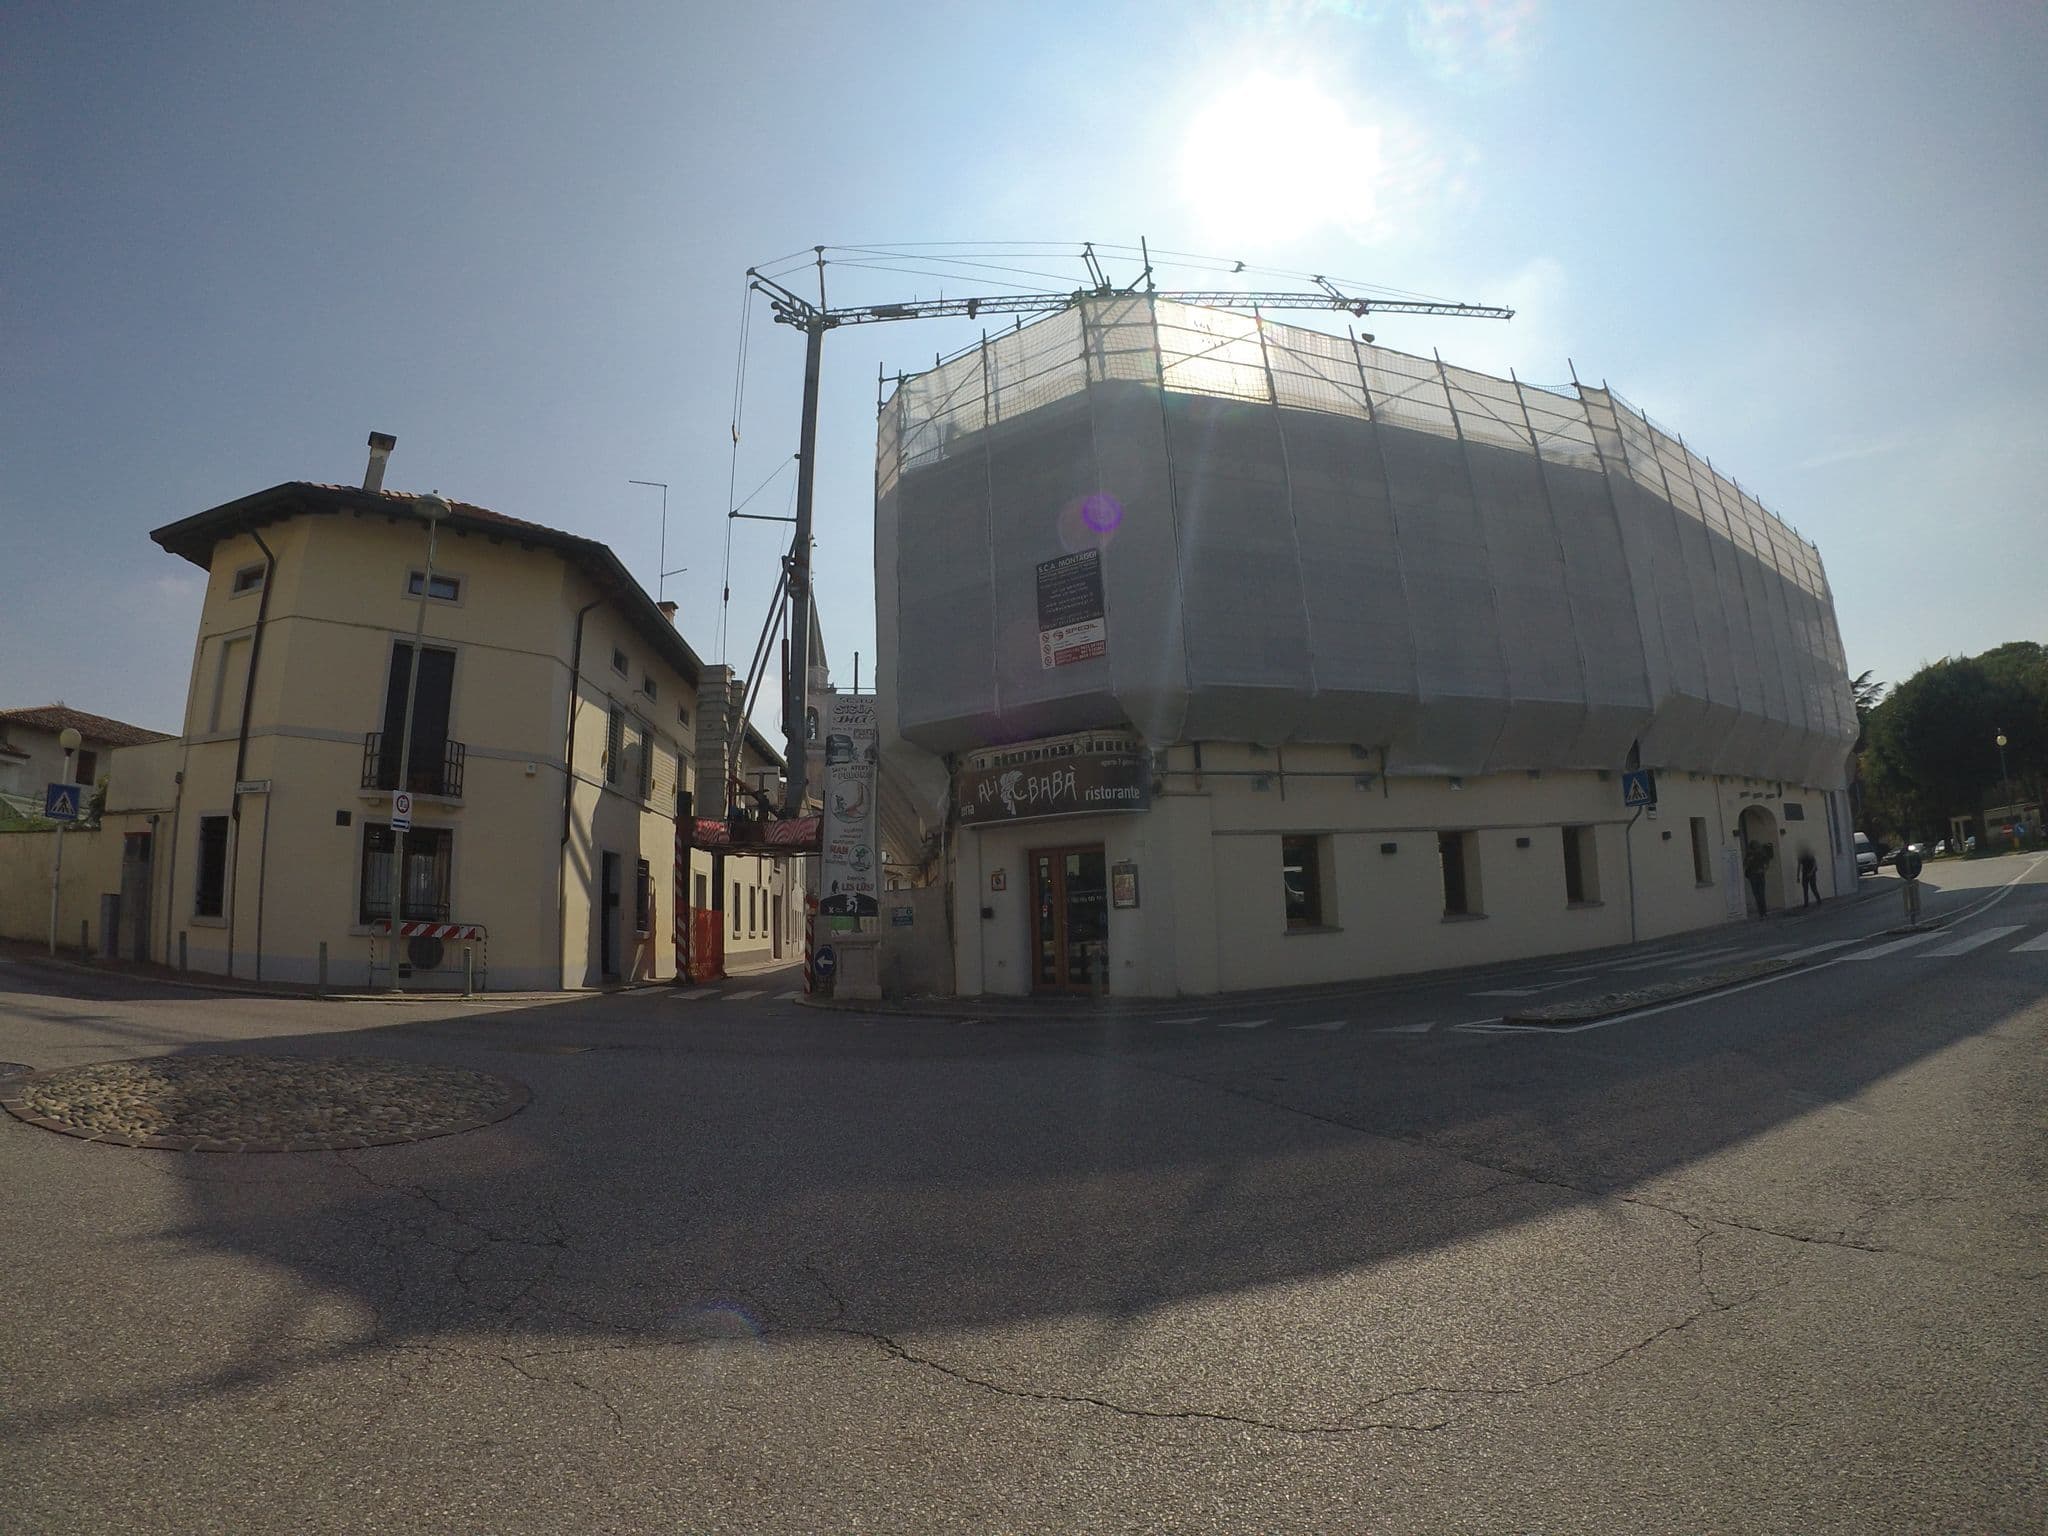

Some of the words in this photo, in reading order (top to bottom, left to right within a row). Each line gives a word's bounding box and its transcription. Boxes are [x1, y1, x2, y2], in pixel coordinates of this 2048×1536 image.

[1058, 551, 1097, 567] MONTAGGI
[979, 776, 999, 806] ALI
[1028, 765, 1079, 806] BABÀ
[1085, 785, 1141, 801] ristorante
